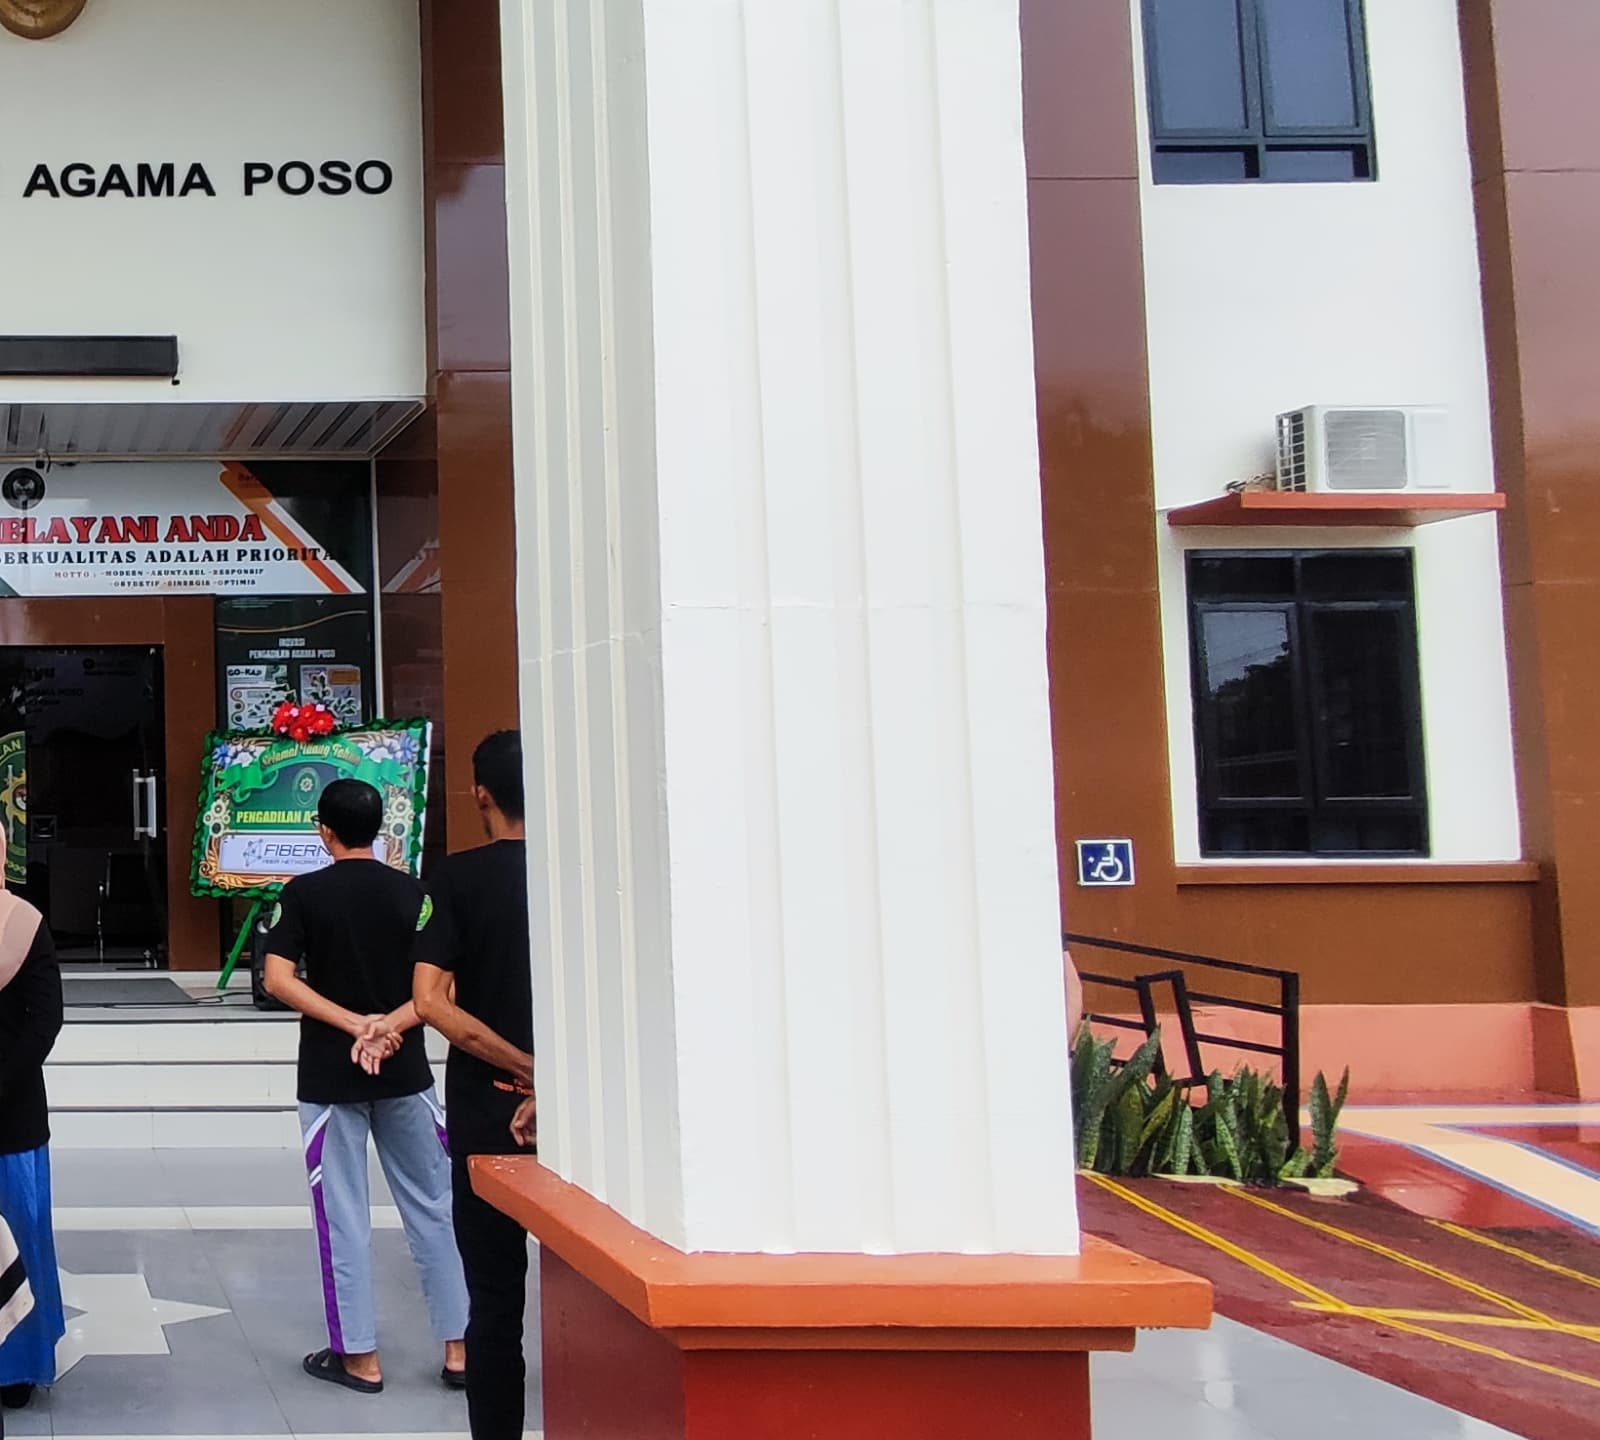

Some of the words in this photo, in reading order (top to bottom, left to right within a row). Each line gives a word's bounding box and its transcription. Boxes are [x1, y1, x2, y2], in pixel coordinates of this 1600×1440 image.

[22, 162, 216, 199] AGAMA
[243, 160, 394, 197] POSO
[164, 514, 267, 543] ANDA
[144, 549, 229, 563] ADALAH
[236, 547, 338, 562] PRIORITA
[236, 810, 302, 824] PENGADILAN
[263, 843, 332, 857] FIBERN
